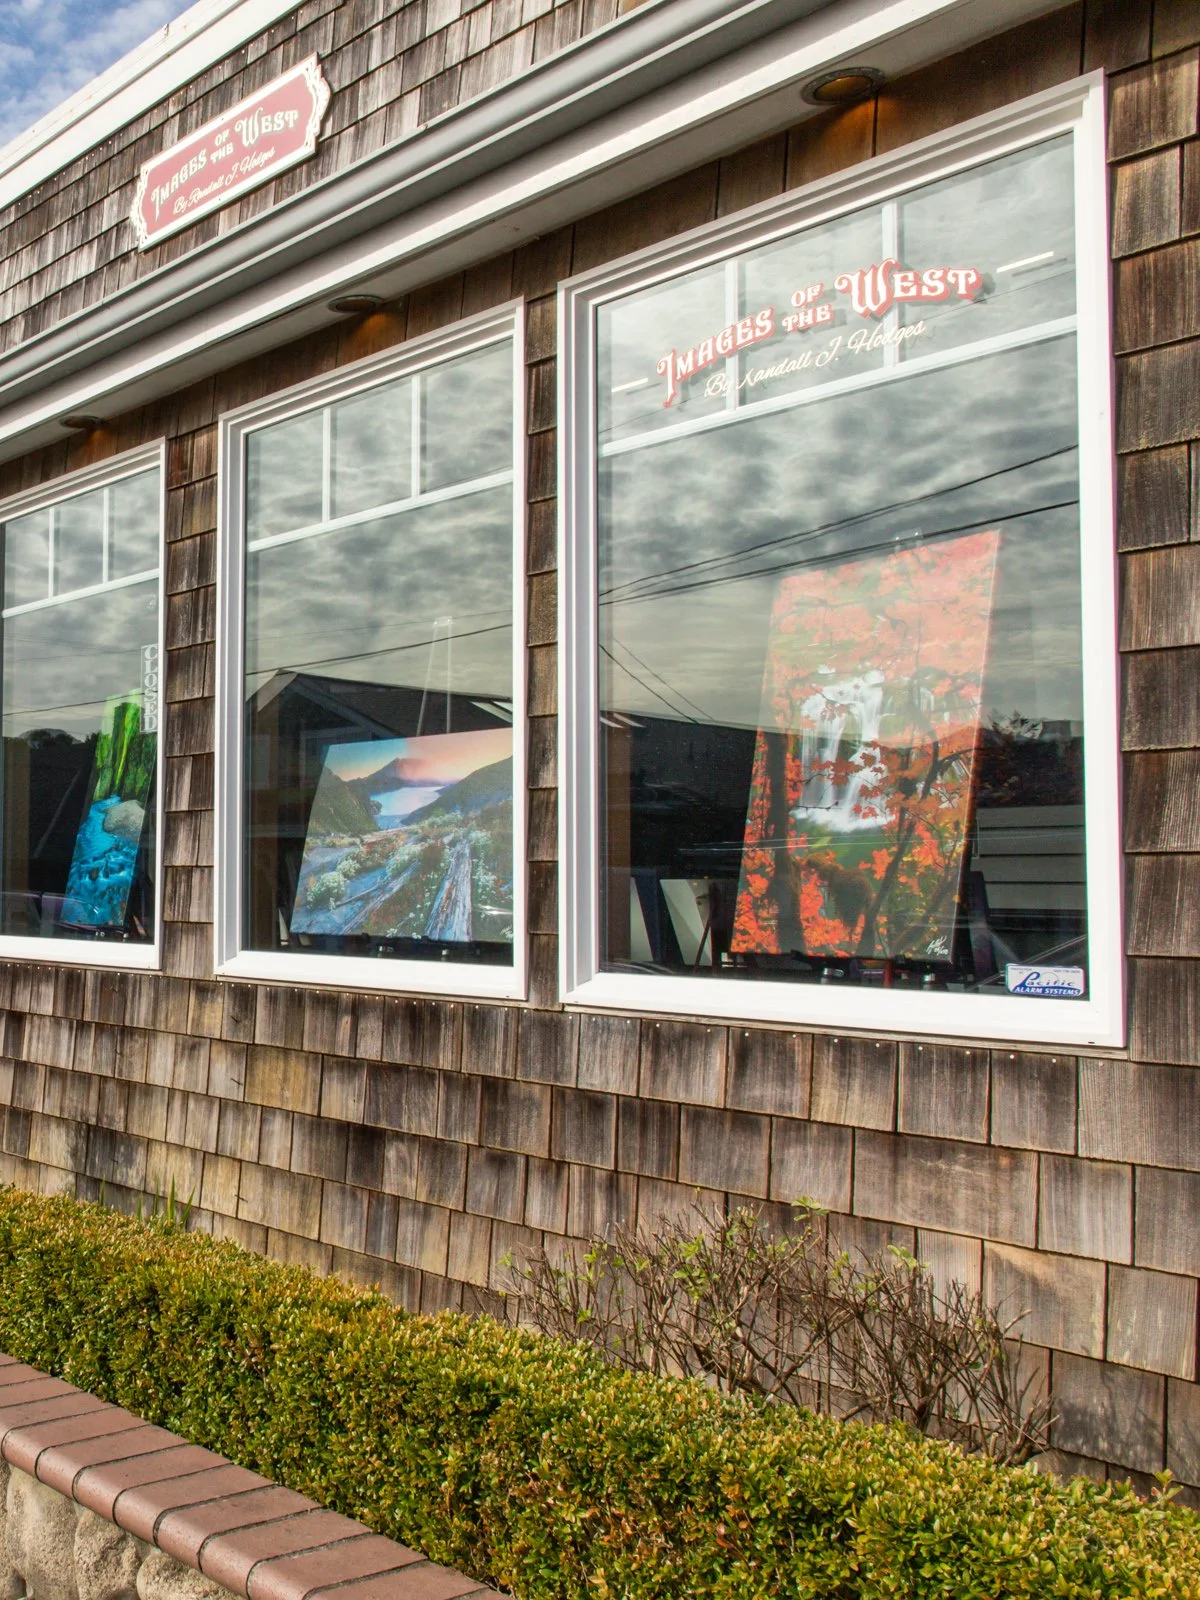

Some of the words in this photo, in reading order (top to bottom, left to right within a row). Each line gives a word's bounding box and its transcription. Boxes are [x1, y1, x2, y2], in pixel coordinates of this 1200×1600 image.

[215, 129, 230, 147] OF
[234, 107, 299, 148] WEST
[210, 142, 234, 165] THE
[173, 197, 188, 215] By
[188, 175, 225, 207] Randall
[224, 162, 239, 187] J.
[240, 146, 276, 176] Hodges
[790, 283, 824, 308] OF
[834, 257, 984, 319] WEST
[781, 303, 835, 335] THE
[816, 335, 842, 369] J.
[848, 320, 926, 355] Hodges
[144, 646, 158, 731] CLOSED
[1014, 971, 1075, 990] Pacific
